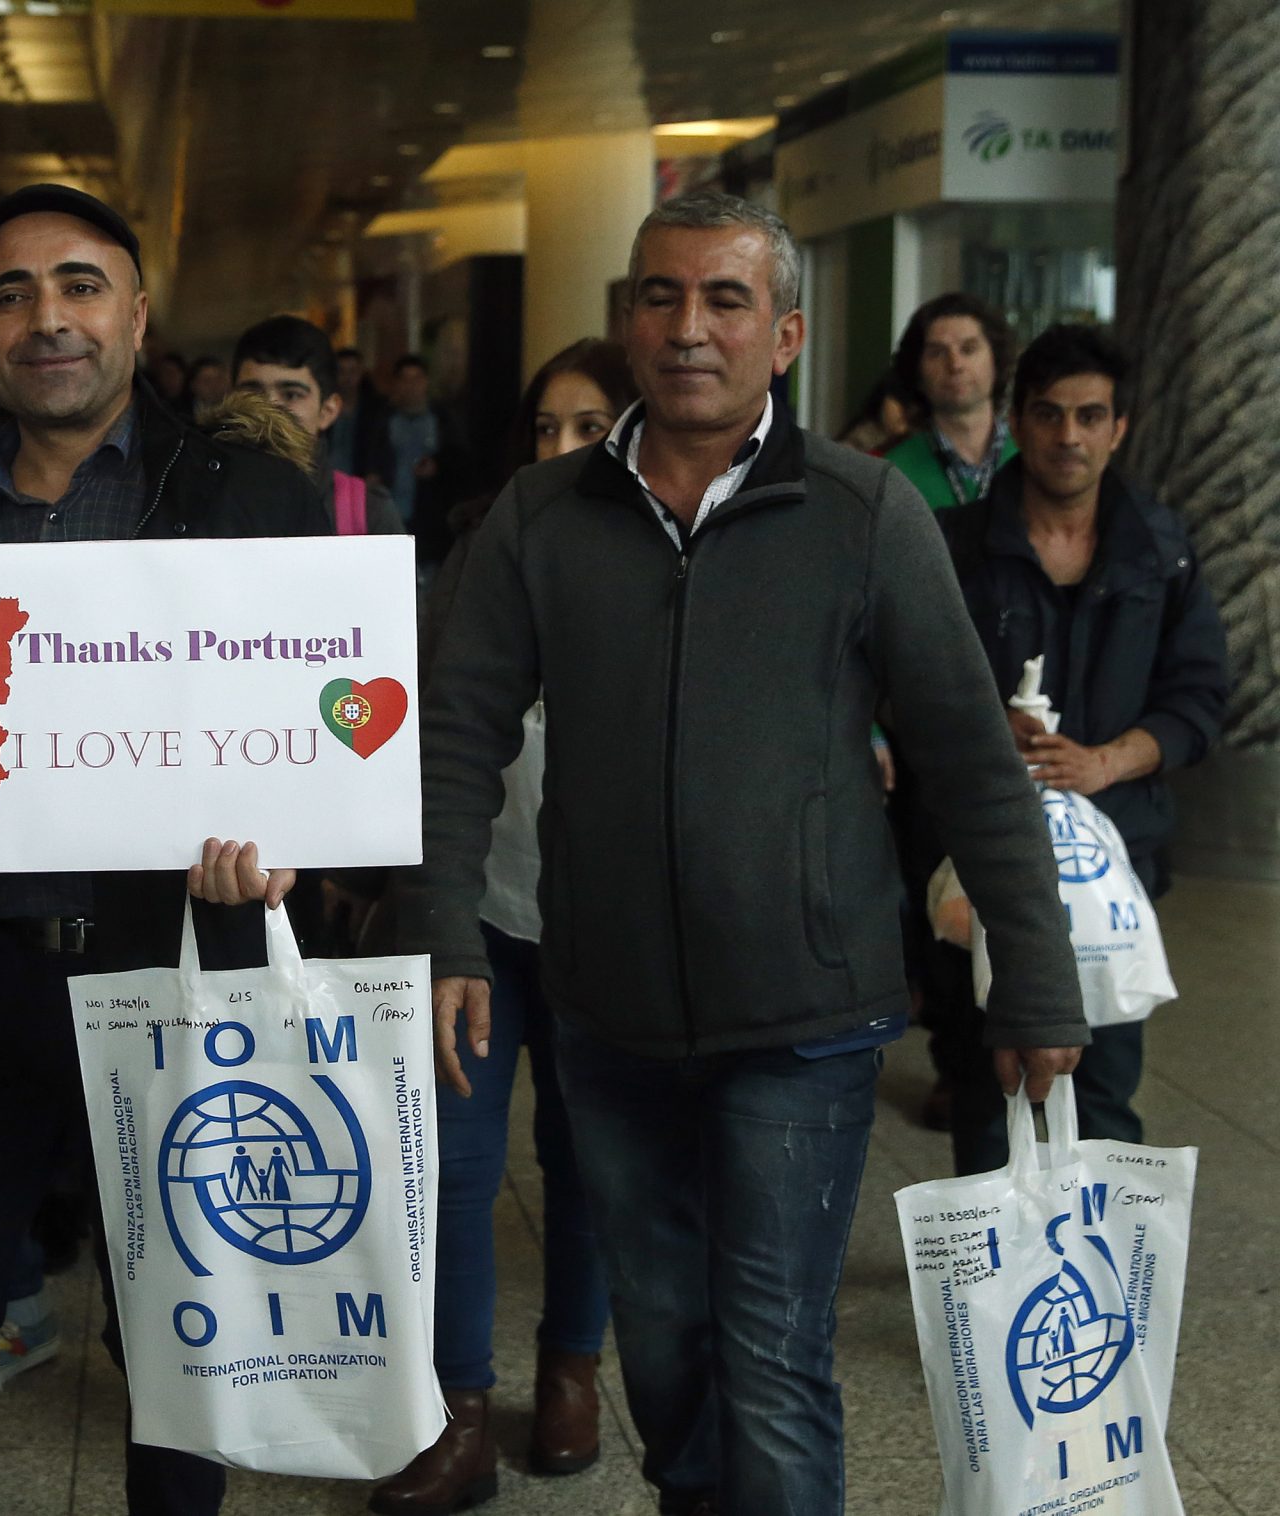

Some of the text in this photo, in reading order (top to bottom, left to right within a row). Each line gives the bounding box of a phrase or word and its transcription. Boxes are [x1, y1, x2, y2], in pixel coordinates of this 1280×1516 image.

[18, 627, 364, 668] Thanks Portugal
[10, 728, 319, 769] I LOVE YOU
[393, 1056, 421, 1283] ORGANISATION INTERNATIONALE
[411, 1088, 424, 1174] MIGRATIONS
[110, 1068, 136, 1281] ORGANIZACION INTERNACIONAL
[123, 1096, 145, 1260] PARA LAS MIGRACIONES
[1138, 1252, 1156, 1322] MIGRATIONS
[182, 1353, 387, 1378] INTERNATIONAL ORGANIZATION
[231, 1368, 338, 1389] FOR MIGRATION
[940, 1276, 981, 1473] ORGANIZACION INTERNACIONAL
[957, 1302, 990, 1453] PARA LAS MIGRACIONES
[1069, 1471, 1140, 1503] ORGANIZATION
